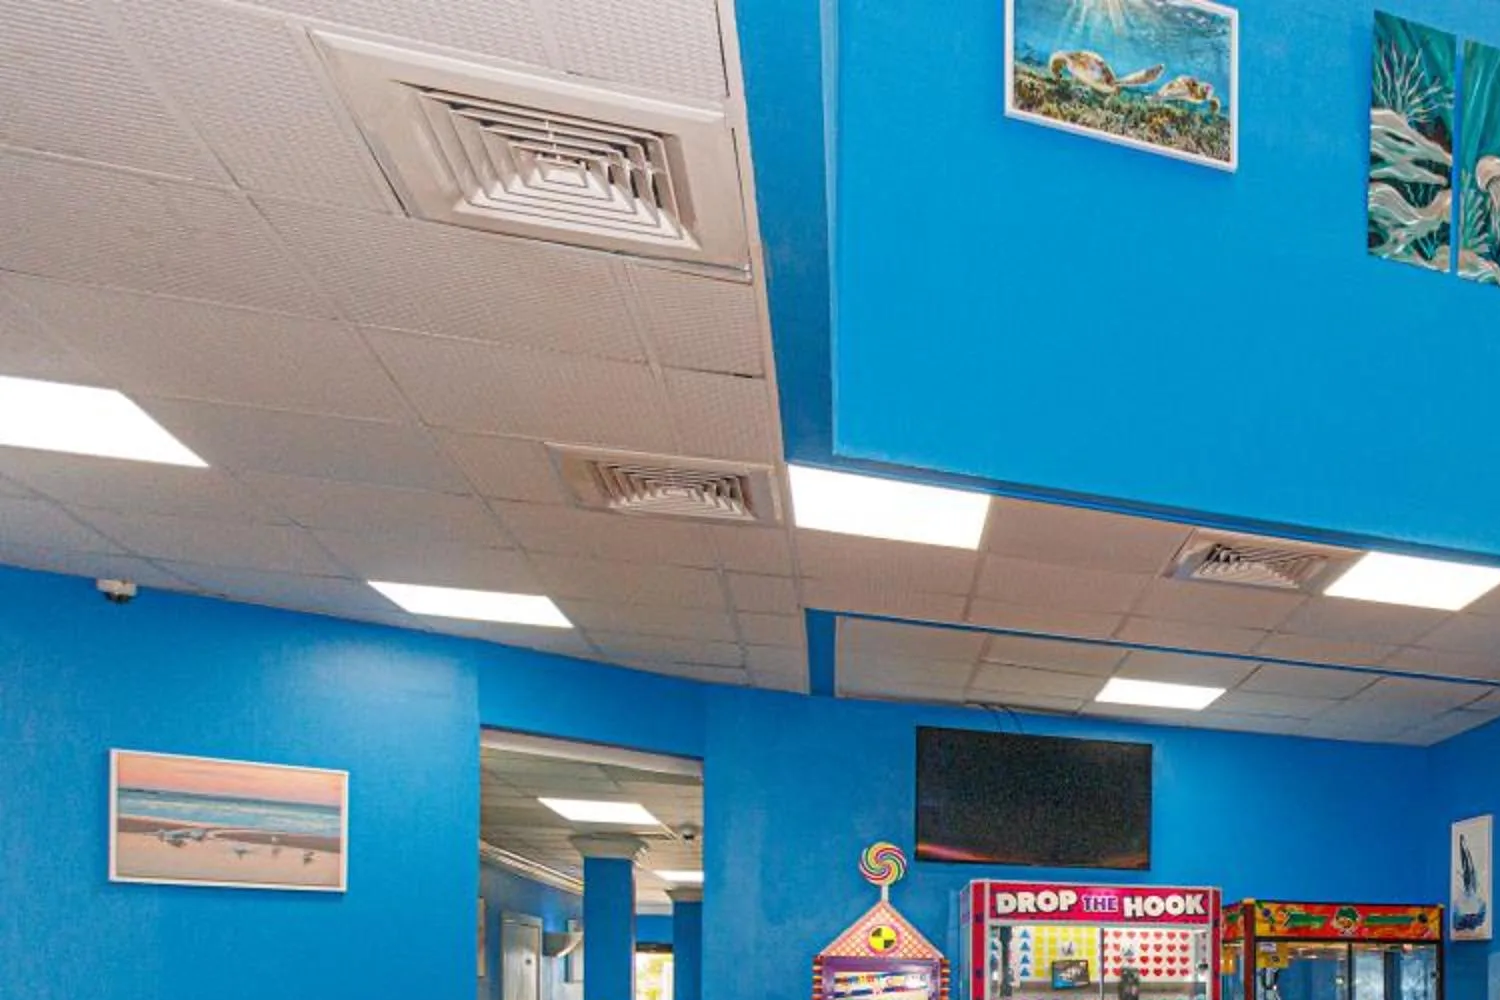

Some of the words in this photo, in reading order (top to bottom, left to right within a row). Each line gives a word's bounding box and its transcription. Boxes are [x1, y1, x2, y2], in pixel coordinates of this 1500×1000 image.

[996, 889, 1077, 914] DROP
[1083, 894, 1119, 912] THE
[1123, 893, 1207, 918] HOOK
